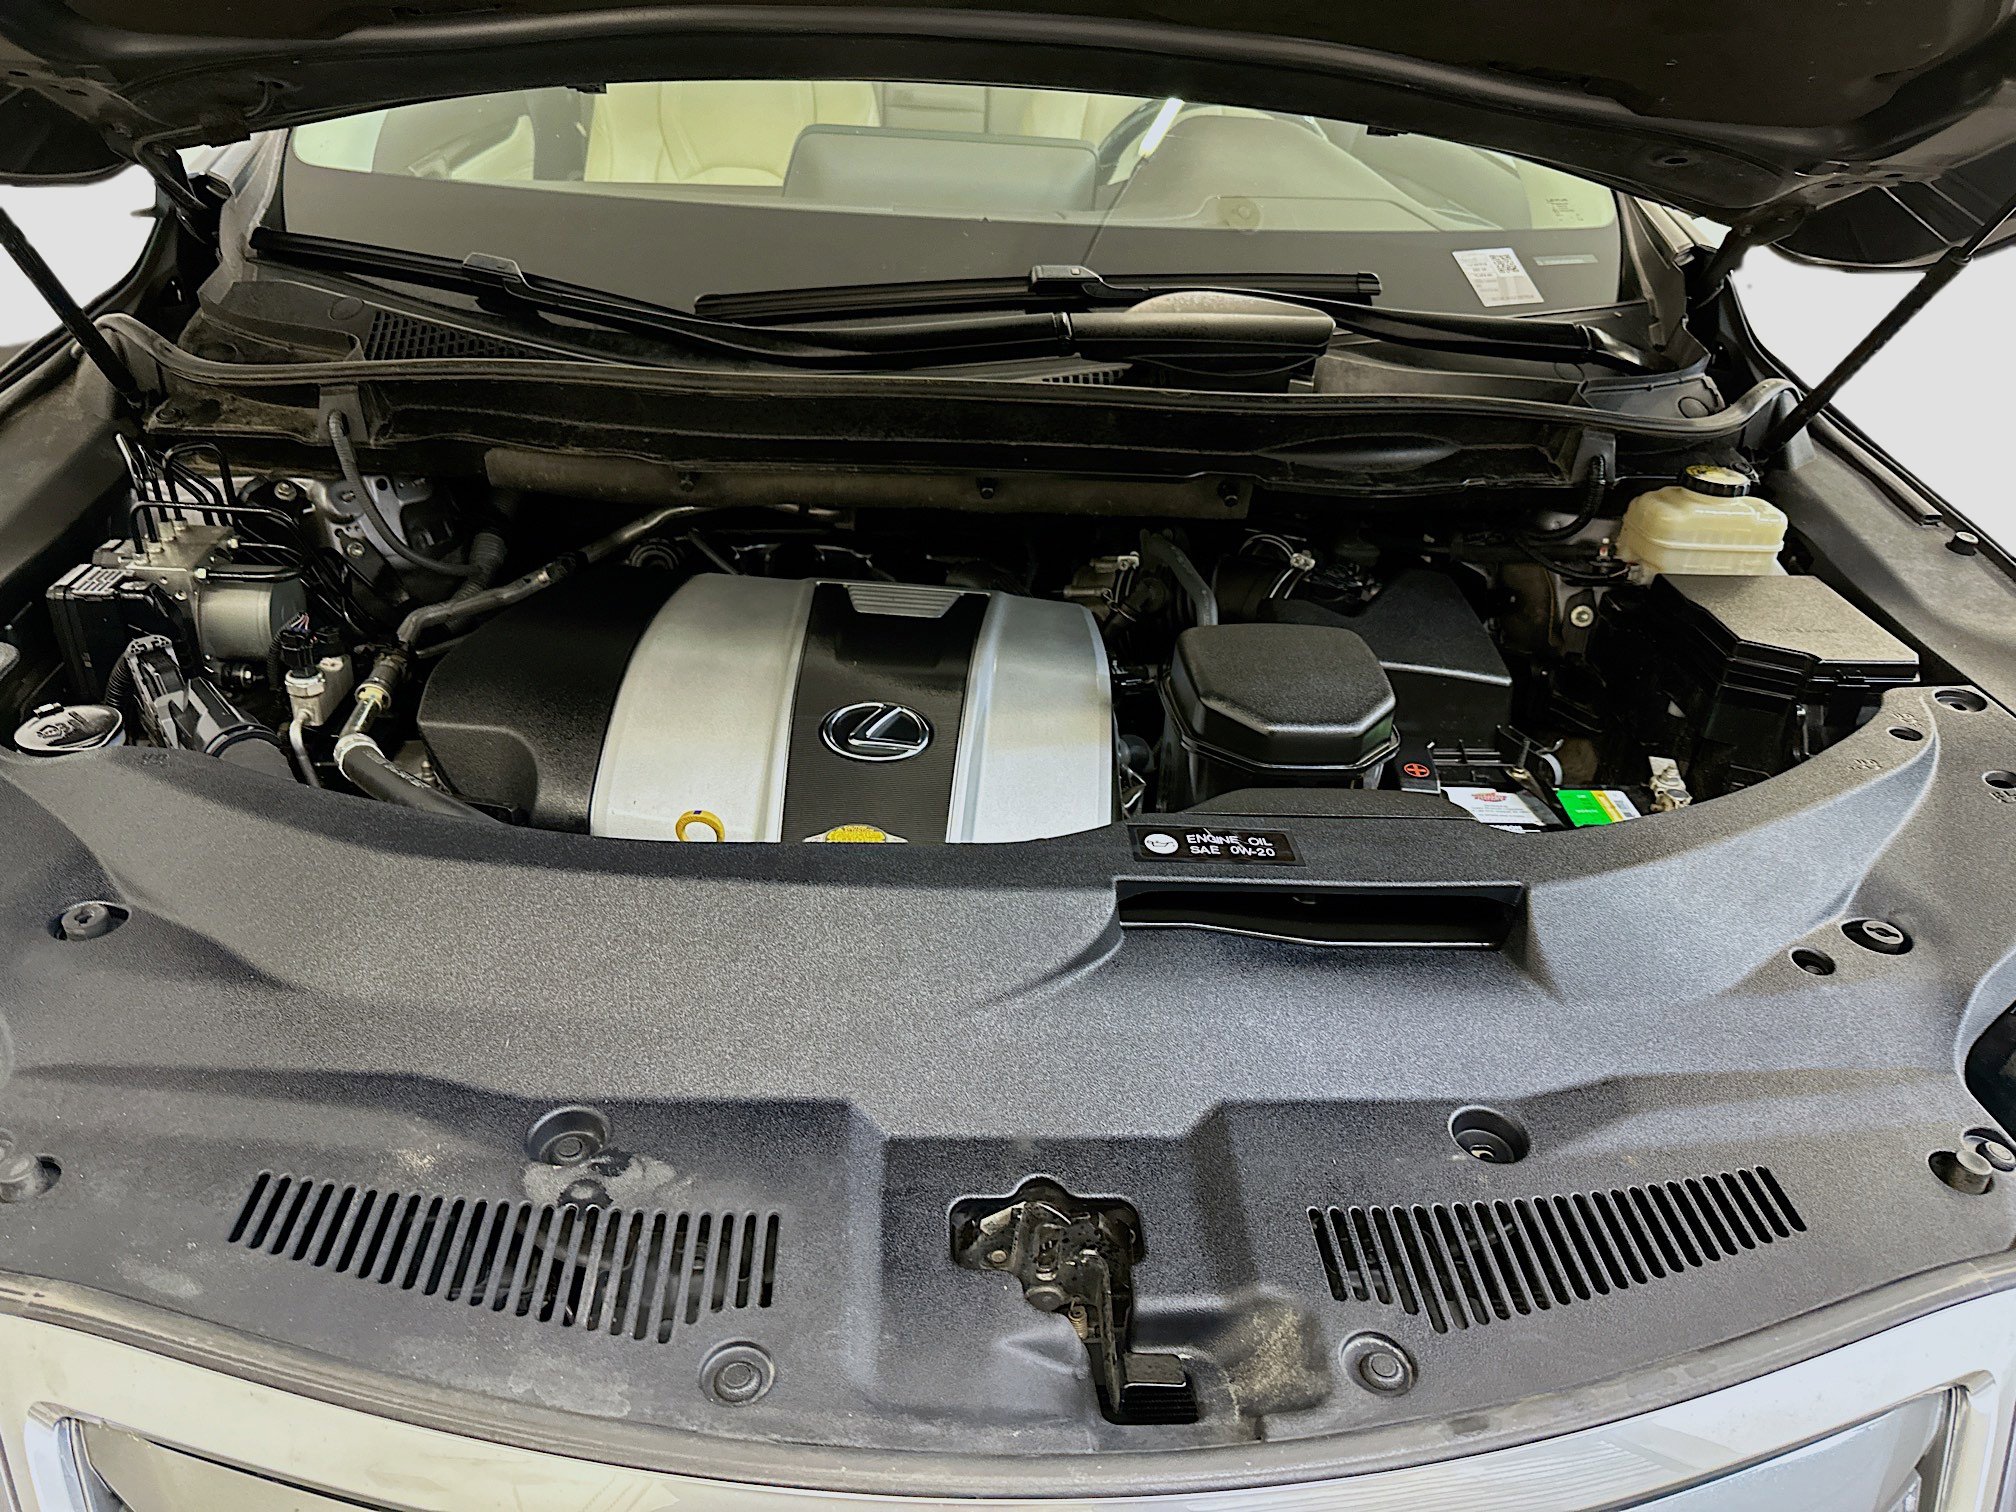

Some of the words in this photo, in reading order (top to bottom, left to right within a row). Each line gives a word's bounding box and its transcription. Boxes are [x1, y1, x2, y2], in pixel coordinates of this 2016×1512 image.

[1185, 833, 1241, 845] ENGINE
[1247, 836, 1274, 847] OIL
[1189, 845, 1221, 855] SAE
[1229, 846, 1276, 857] 0W-20
